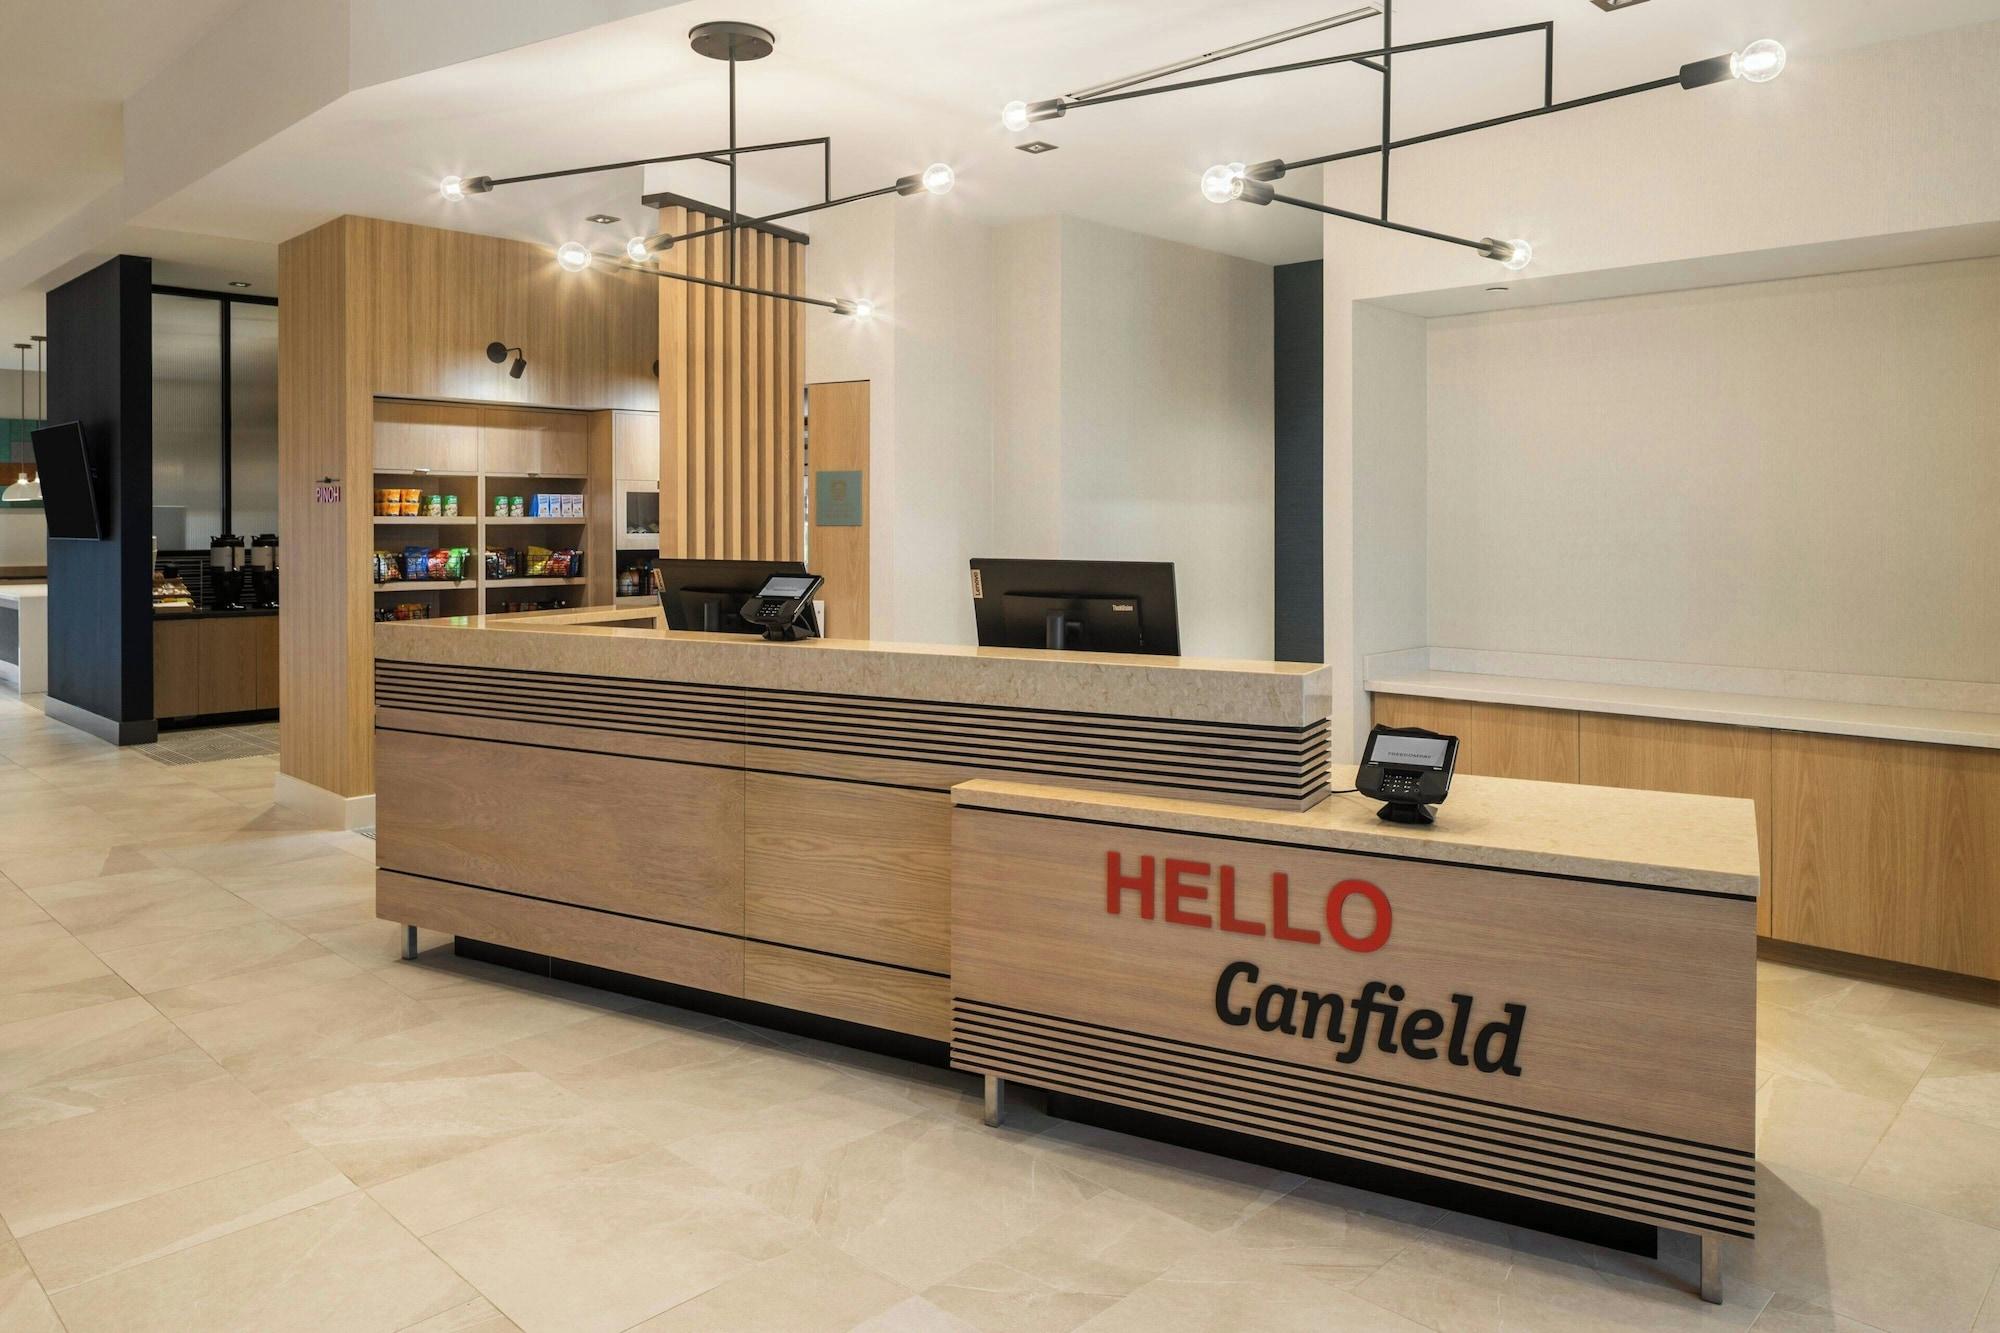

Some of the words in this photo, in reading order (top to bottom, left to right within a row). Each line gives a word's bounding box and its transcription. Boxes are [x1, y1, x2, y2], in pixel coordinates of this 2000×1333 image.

[316, 486, 341, 503] PINCH
[973, 571, 981, 596] Lenovo
[1106, 851, 1393, 953] HELLO
[1214, 961, 1528, 1077] Canfield
